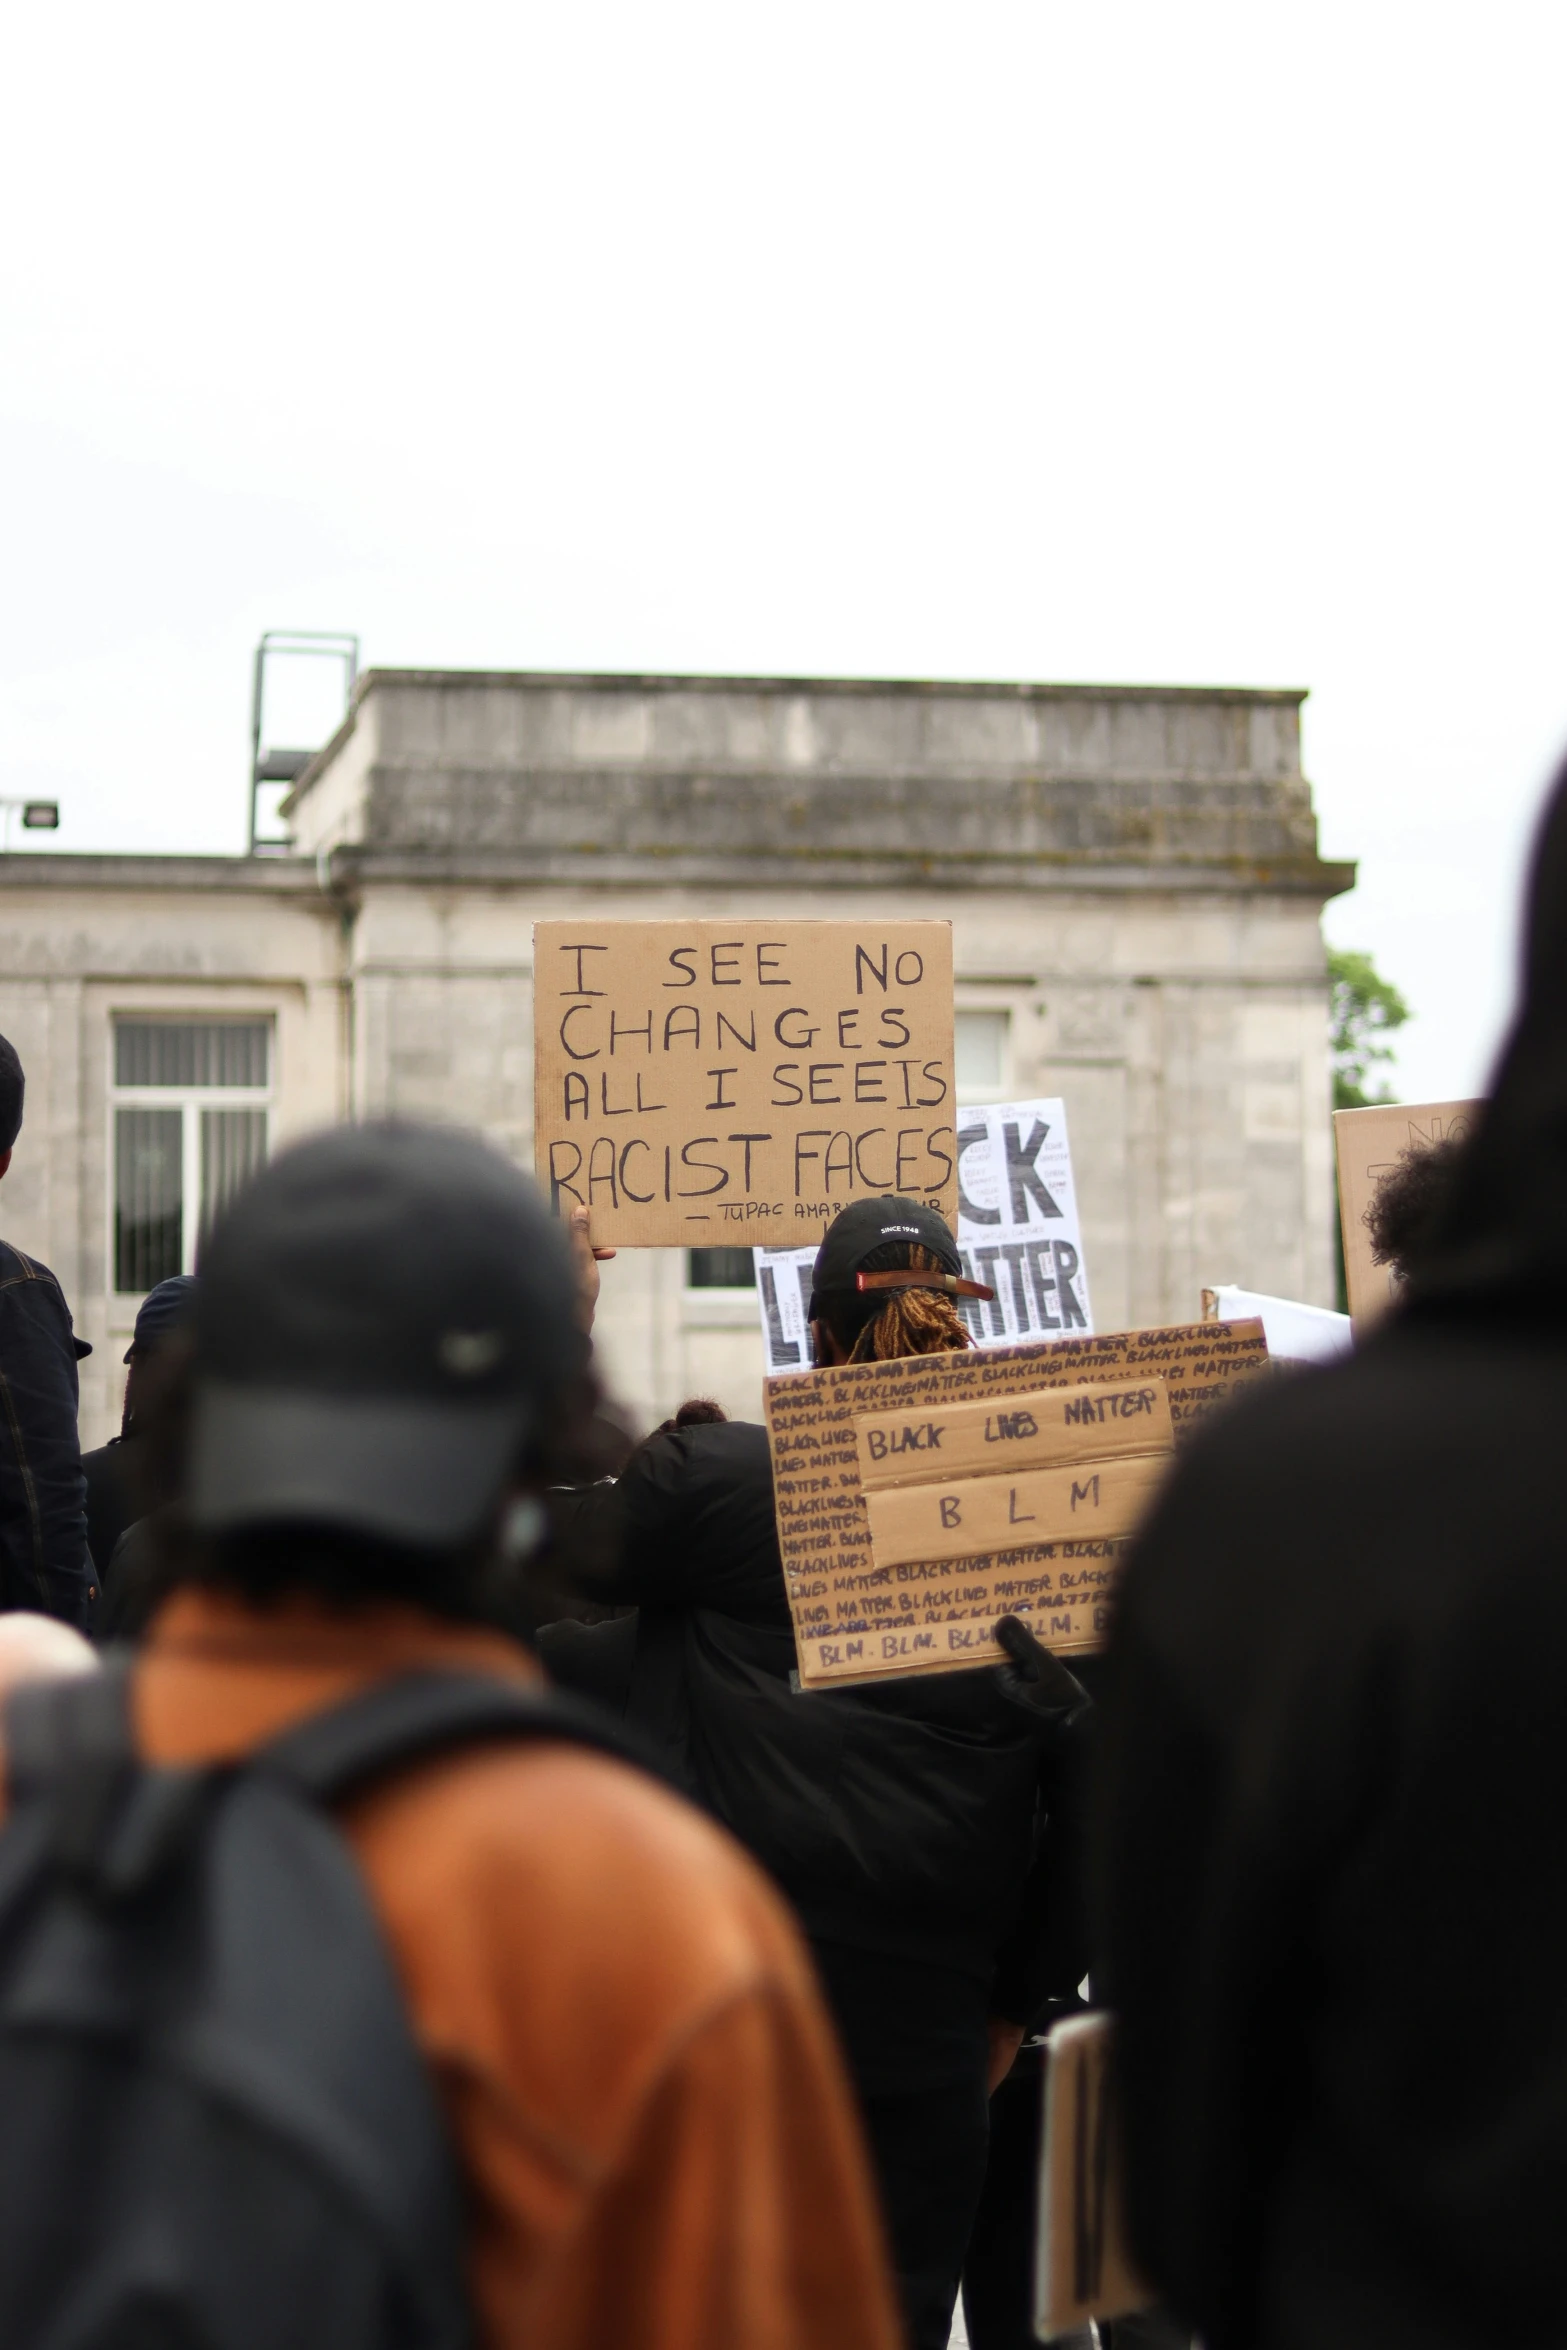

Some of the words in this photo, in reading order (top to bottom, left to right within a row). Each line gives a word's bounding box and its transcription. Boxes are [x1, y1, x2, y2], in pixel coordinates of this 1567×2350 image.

[558, 944, 609, 997] I
[661, 942, 791, 987] SEE
[855, 943, 924, 995] NO
[559, 1004, 911, 1061] CHANGES
[563, 1071, 668, 1121] ALL
[705, 1067, 739, 1111] I
[770, 1060, 888, 1106] SEE
[891, 1059, 947, 1110] IS
[549, 1133, 773, 1211] RACIST
[795, 1126, 953, 1197] FACES
[717, 1202, 784, 1222] TUPAC
[881, 1226, 901, 1234] SINCE
[902, 1226, 919, 1234] 1948
[768, 1371, 827, 1396] BLACK
[829, 1365, 874, 1387] LIVES
[833, 1383, 883, 1404] BLACK
[981, 1363, 1026, 1383] BLACK
[1125, 1346, 1176, 1364] BLACK
[771, 1412, 819, 1433] BLACK
[821, 1428, 858, 1446] LIVES
[867, 1423, 947, 1461] BLACK
[778, 1497, 820, 1518] BLACK
[938, 1495, 962, 1529] B
[1008, 1488, 1036, 1525] L
[1069, 1474, 1100, 1512] M
[828, 1552, 868, 1570] LIVES
[896, 1560, 952, 1582] BLACK
[898, 1589, 953, 1612] BLACK
[881, 1631, 937, 1659] BLM.
